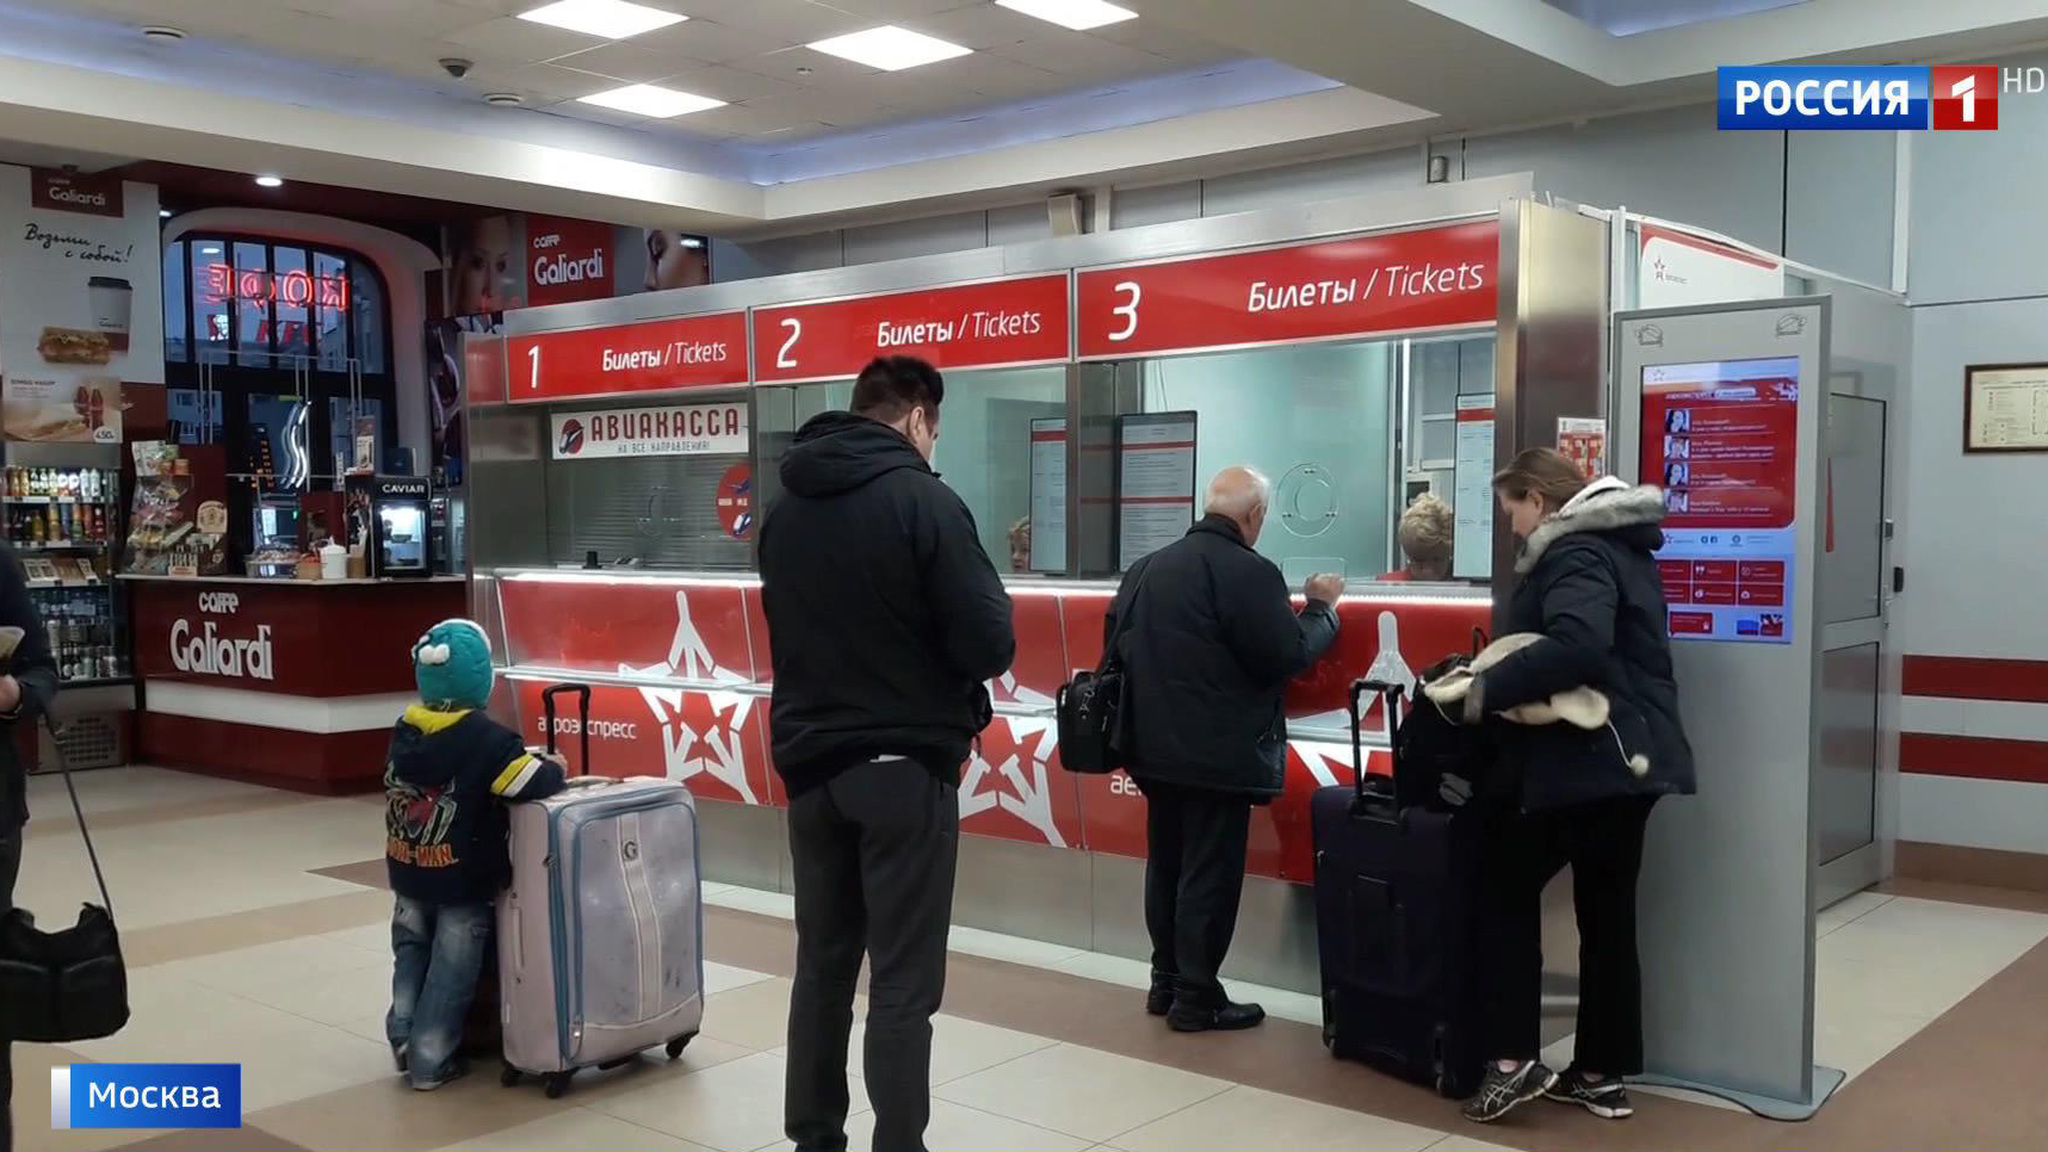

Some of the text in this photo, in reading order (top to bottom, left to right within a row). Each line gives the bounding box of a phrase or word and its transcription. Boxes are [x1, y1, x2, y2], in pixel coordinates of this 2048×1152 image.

[49, 186, 106, 206] Galiardi
[24, 222, 90, 249] Возьми
[65, 250, 73, 258] с
[534, 247, 604, 286] Galiardi
[1107, 281, 1142, 342] 3
[1247, 277, 1356, 312] Билеты
[1385, 262, 1484, 297] Tickets
[776, 317, 801, 369] 2
[877, 321, 953, 348] Билеты
[972, 310, 1041, 339] Tickets
[528, 344, 540, 389] 1
[602, 349, 662, 372] Билеты
[674, 341, 728, 365] Tickets
[591, 408, 739, 442] АВИАКАССА
[381, 483, 425, 494] CAVIAR
[198, 591, 239, 614] caffe
[170, 618, 274, 680] Galiardi
[537, 716, 637, 741] ароэспресс
[1110, 774, 1142, 797] ae
